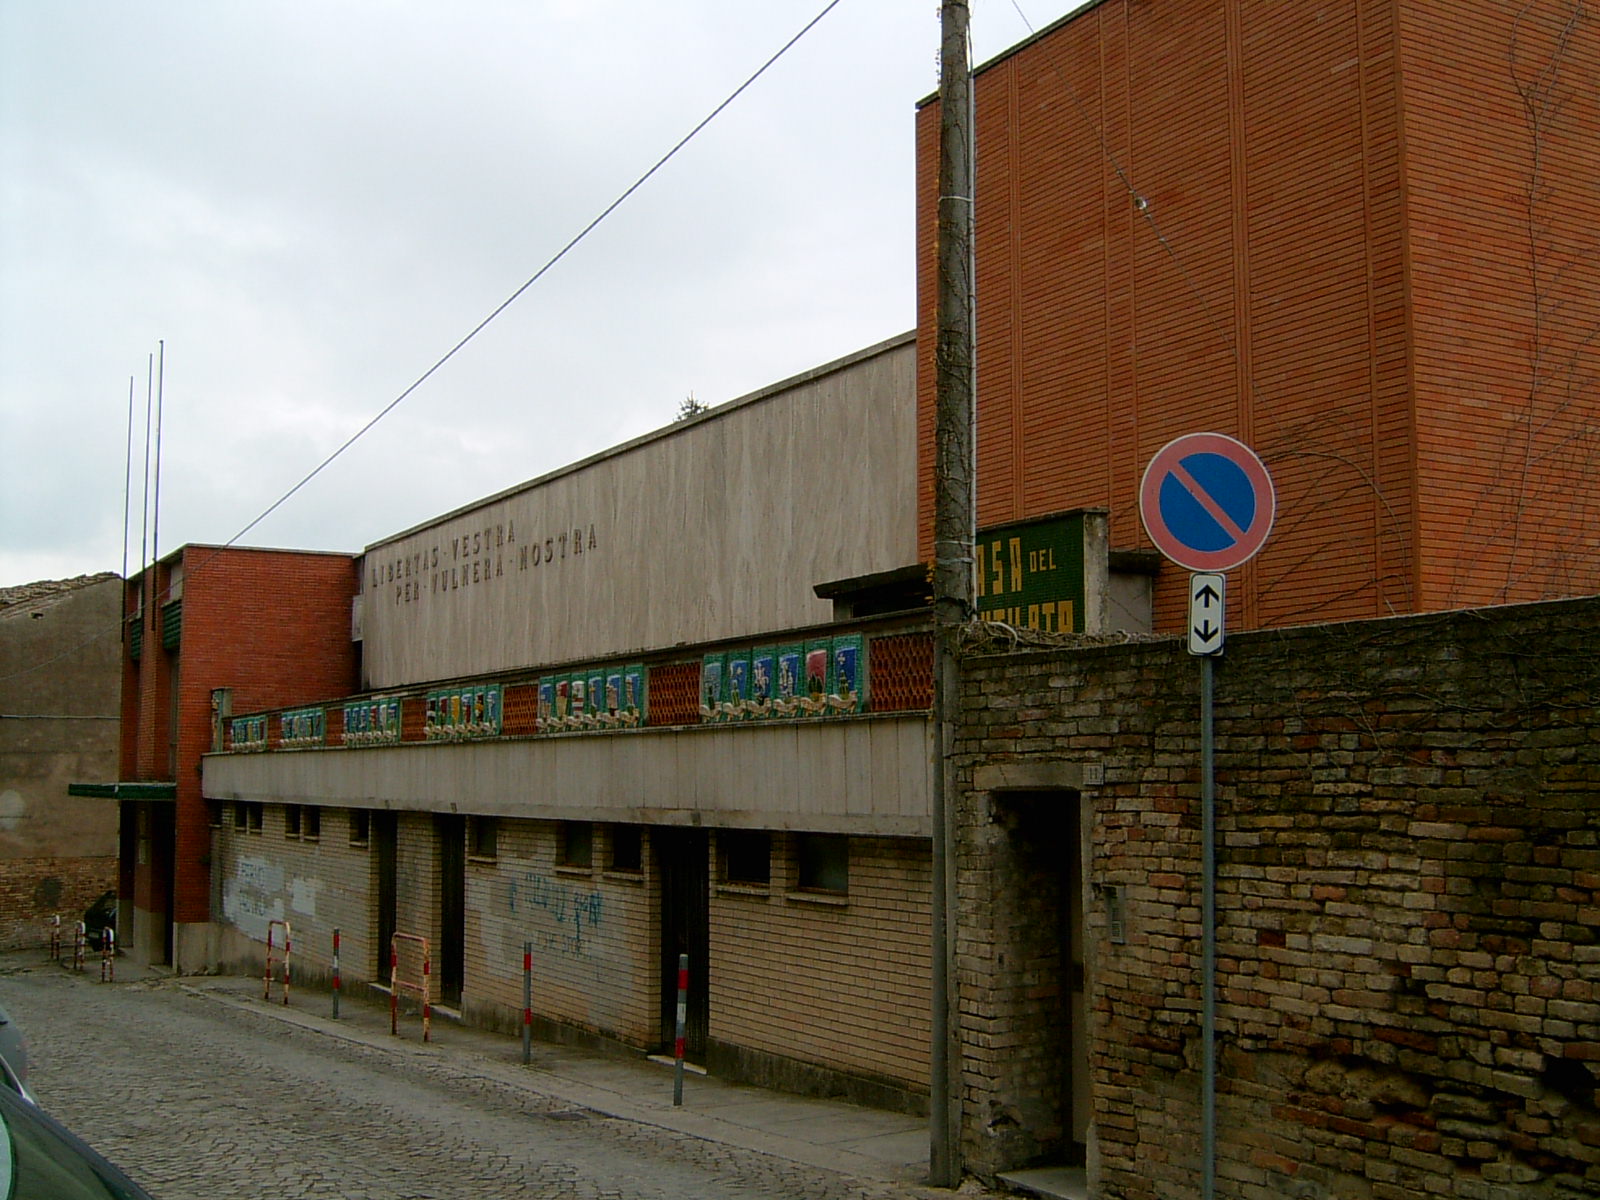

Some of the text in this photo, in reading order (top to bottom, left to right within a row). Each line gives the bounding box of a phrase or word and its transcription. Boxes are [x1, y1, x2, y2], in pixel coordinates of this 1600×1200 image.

[372, 519, 516, 588] LIBERTAS VESTRA
[395, 523, 598, 606] PER VULNERA NOSTRA
[976, 537, 1057, 597] ASA DEL
